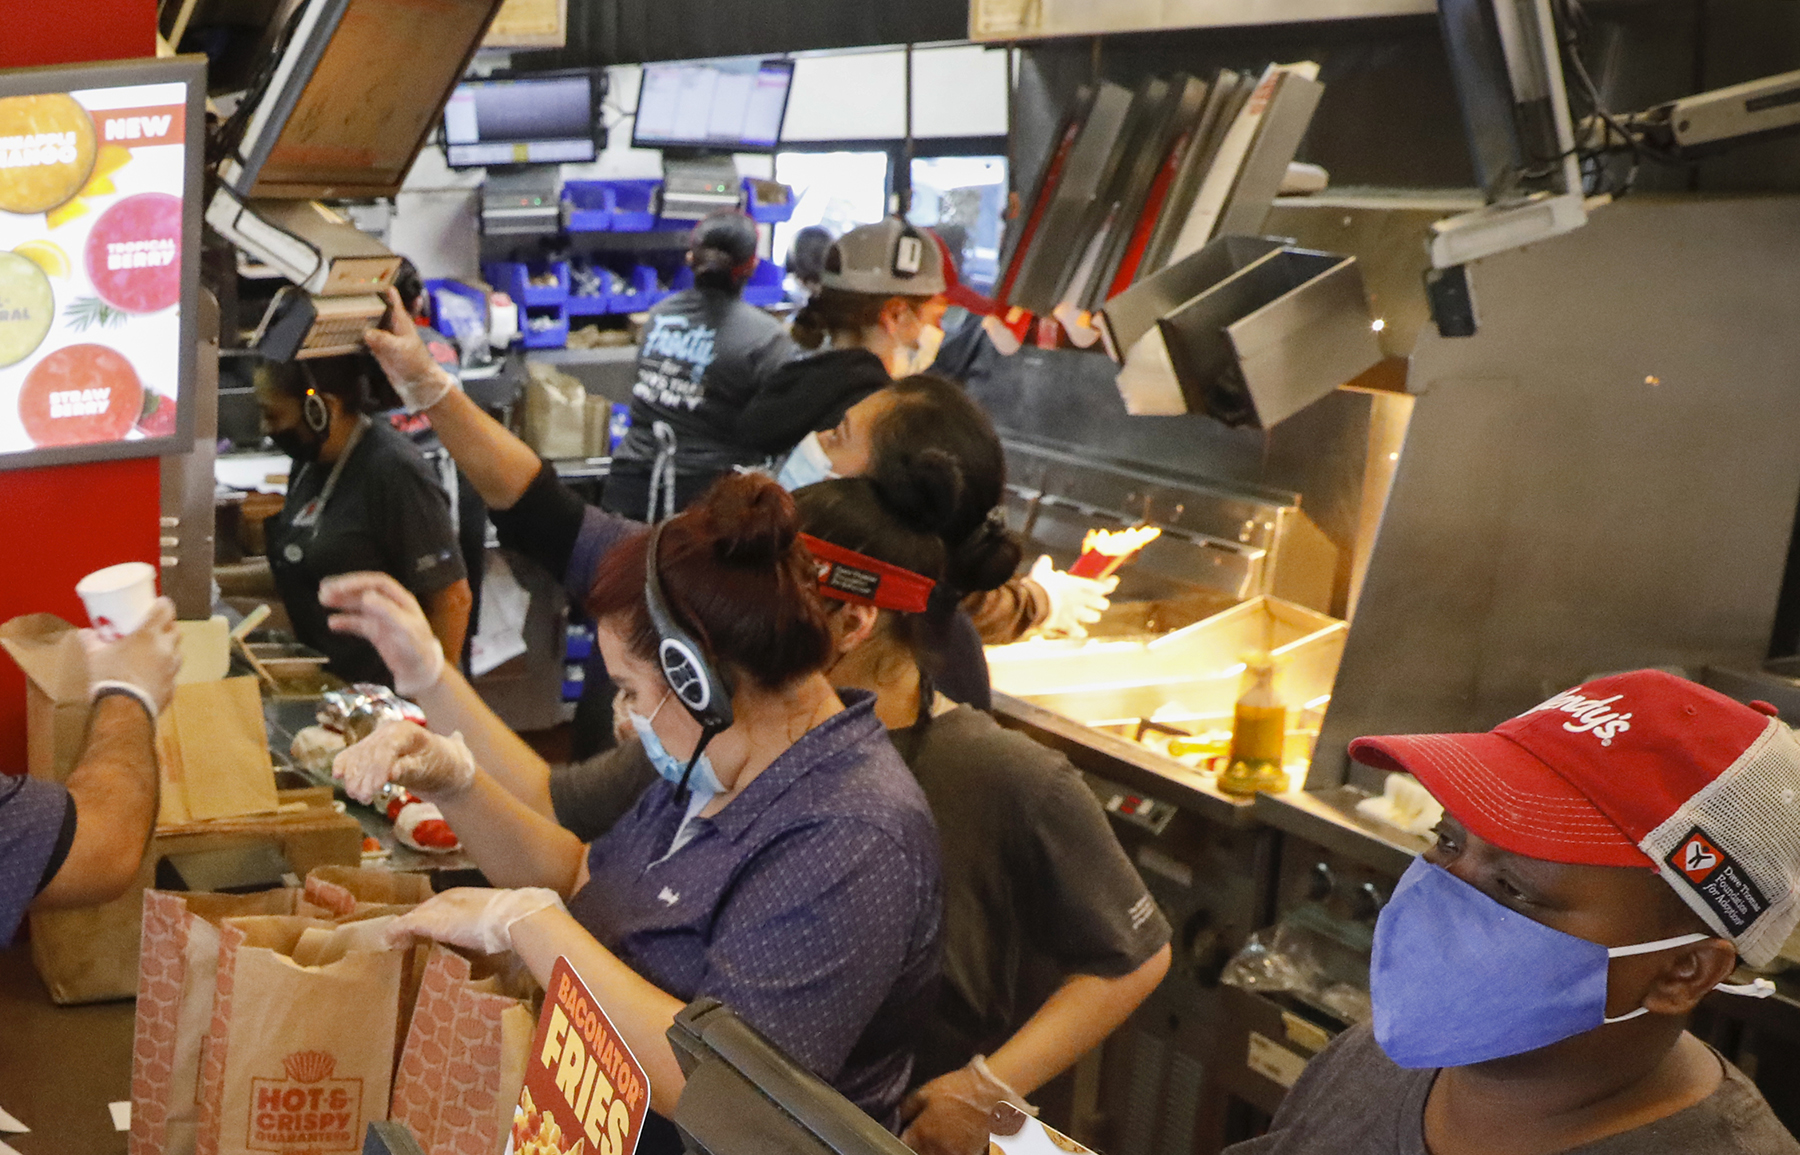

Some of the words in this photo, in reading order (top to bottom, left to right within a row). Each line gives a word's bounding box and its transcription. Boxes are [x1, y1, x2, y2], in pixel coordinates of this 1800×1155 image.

[105, 114, 172, 140] NEW
[107, 237, 175, 256] TROPICAL
[108, 251, 176, 270] BERRY
[49, 387, 111, 406] STRAW
[50, 399, 111, 419] BERRY
[1723, 866, 1741, 887] Dave
[1703, 883, 1720, 895] for
[1715, 874, 1747, 914] Foundation
[257, 1087, 325, 1112] HOT
[256, 1112, 351, 1131] CRISPY
